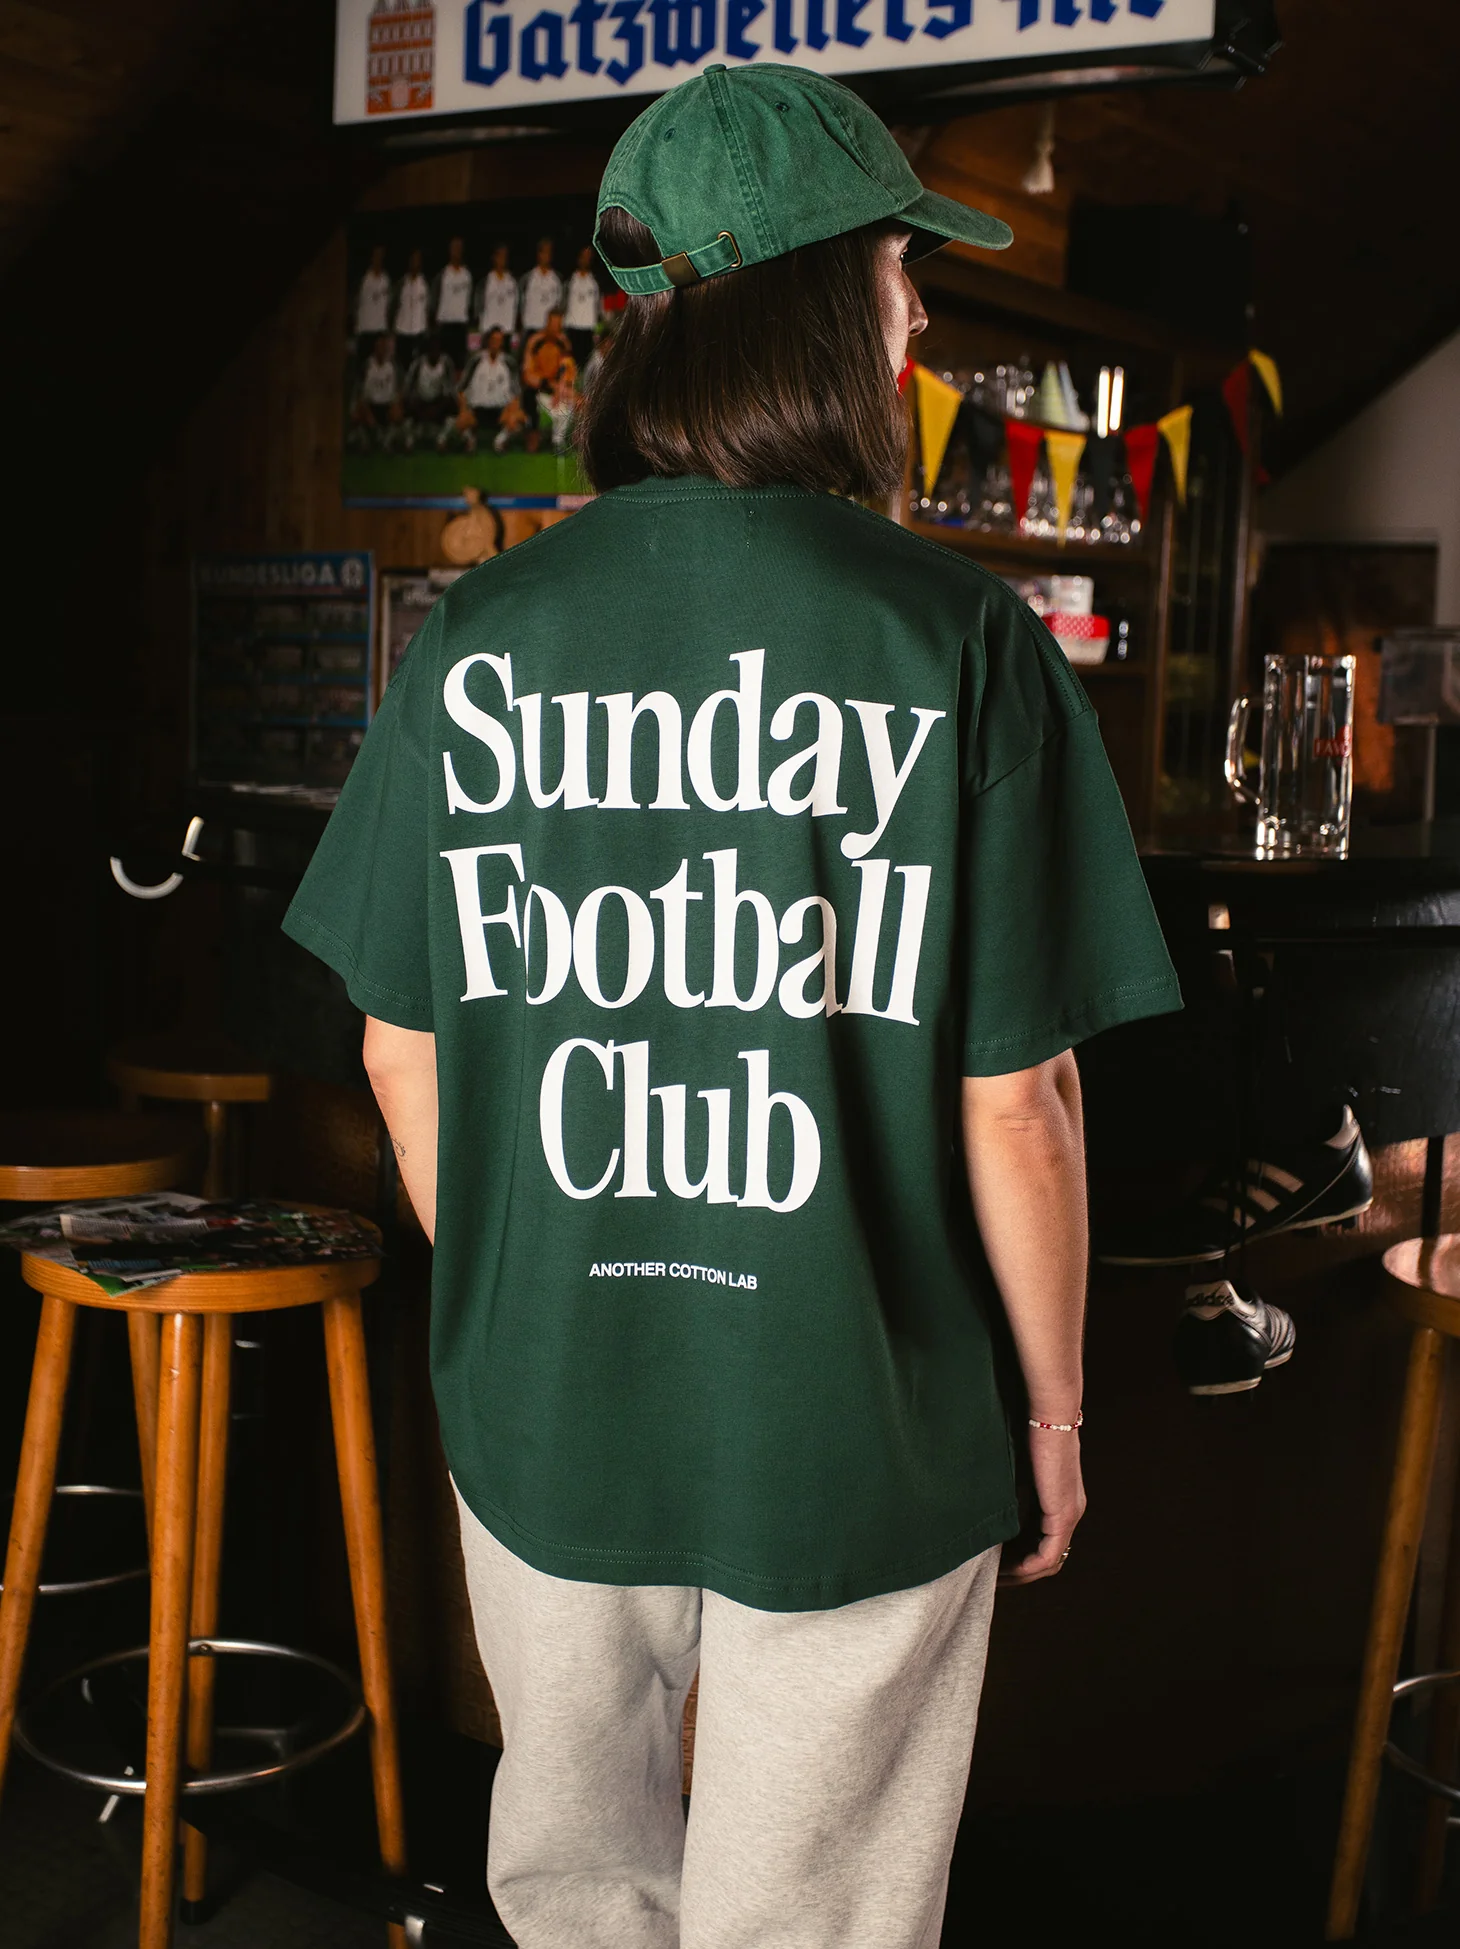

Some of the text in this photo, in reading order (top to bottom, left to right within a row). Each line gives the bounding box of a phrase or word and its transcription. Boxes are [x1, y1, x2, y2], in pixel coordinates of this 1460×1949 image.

[442, 648, 947, 860] Sunday
[439, 842, 933, 1027] Football
[539, 1037, 822, 1213] Club
[588, 1262, 758, 1291] ANOTHER COTTON LAB
